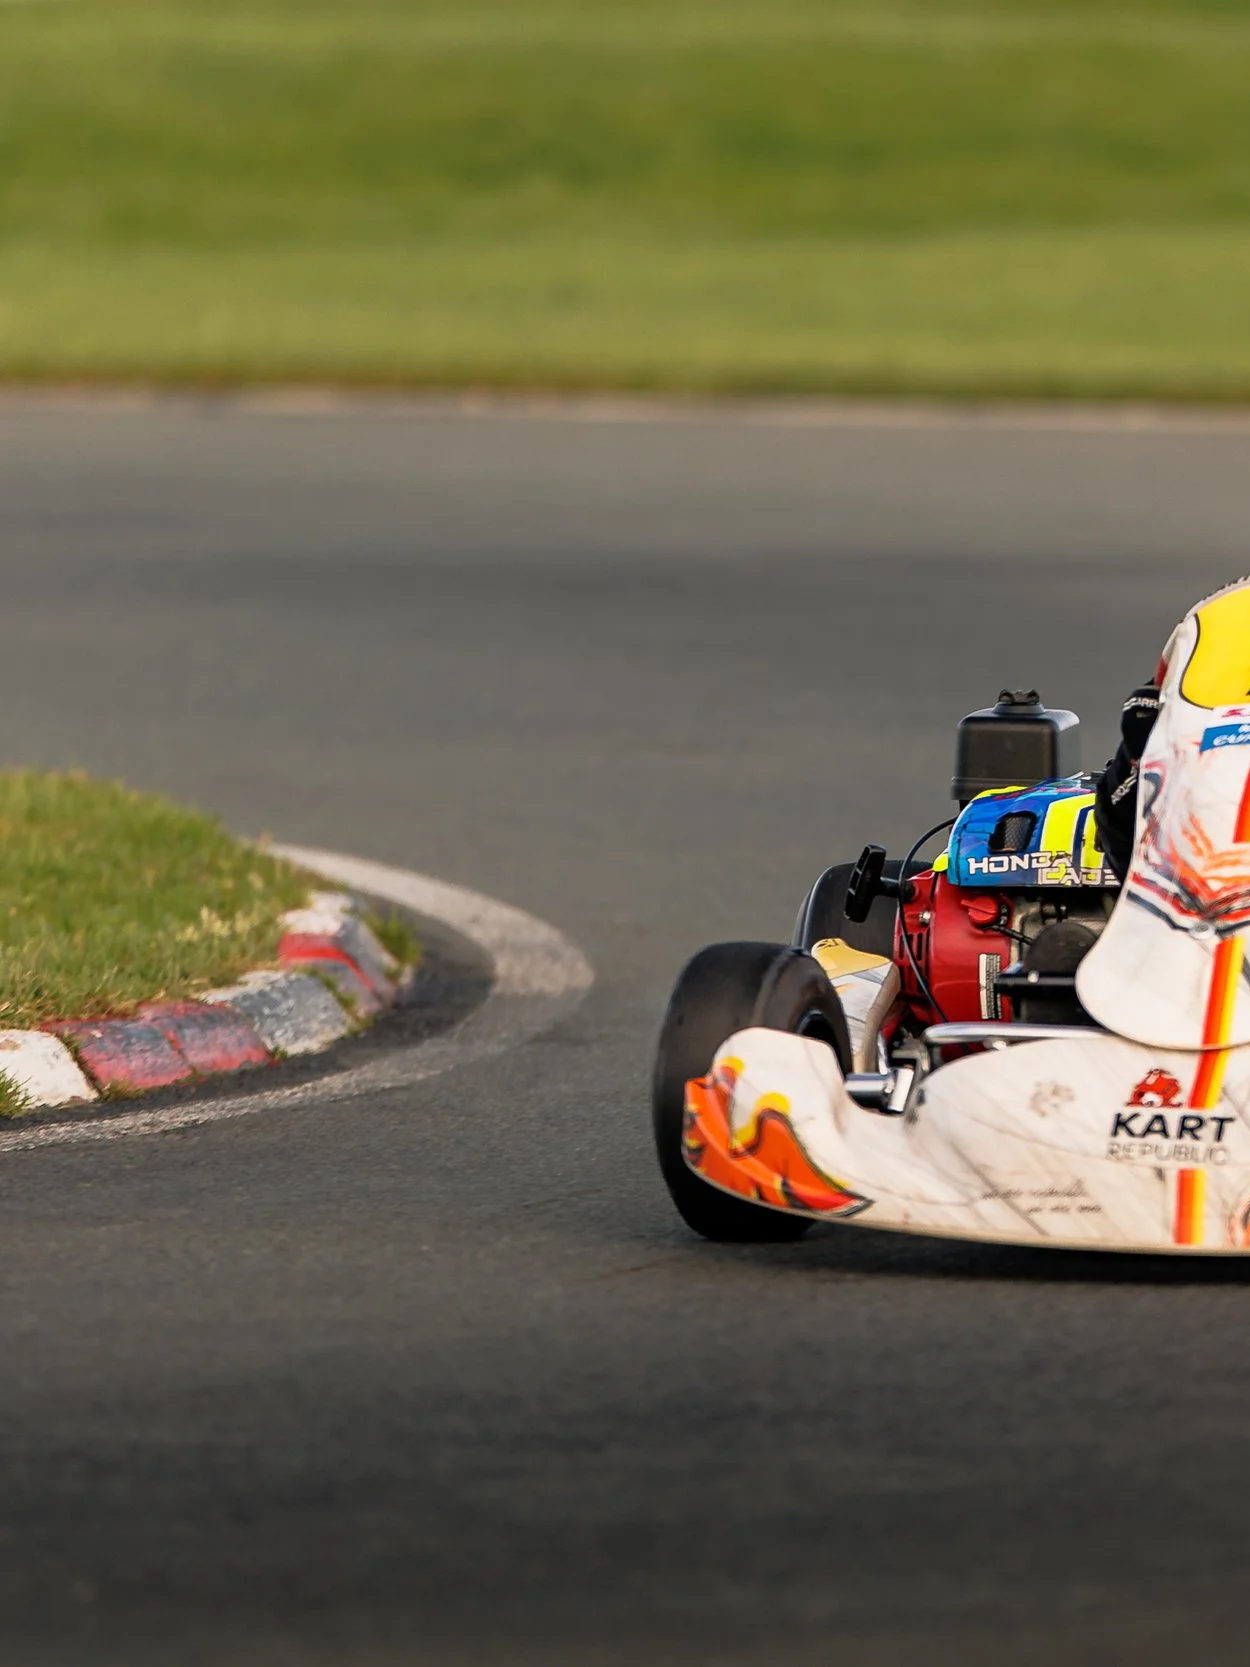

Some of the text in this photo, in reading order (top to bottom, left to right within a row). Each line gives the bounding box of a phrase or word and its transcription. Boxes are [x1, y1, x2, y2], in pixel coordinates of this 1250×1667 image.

[967, 850, 1073, 875] HONDA
[1110, 1111, 1236, 1142] KART
[1106, 1141, 1231, 1166] REPUBLIC
